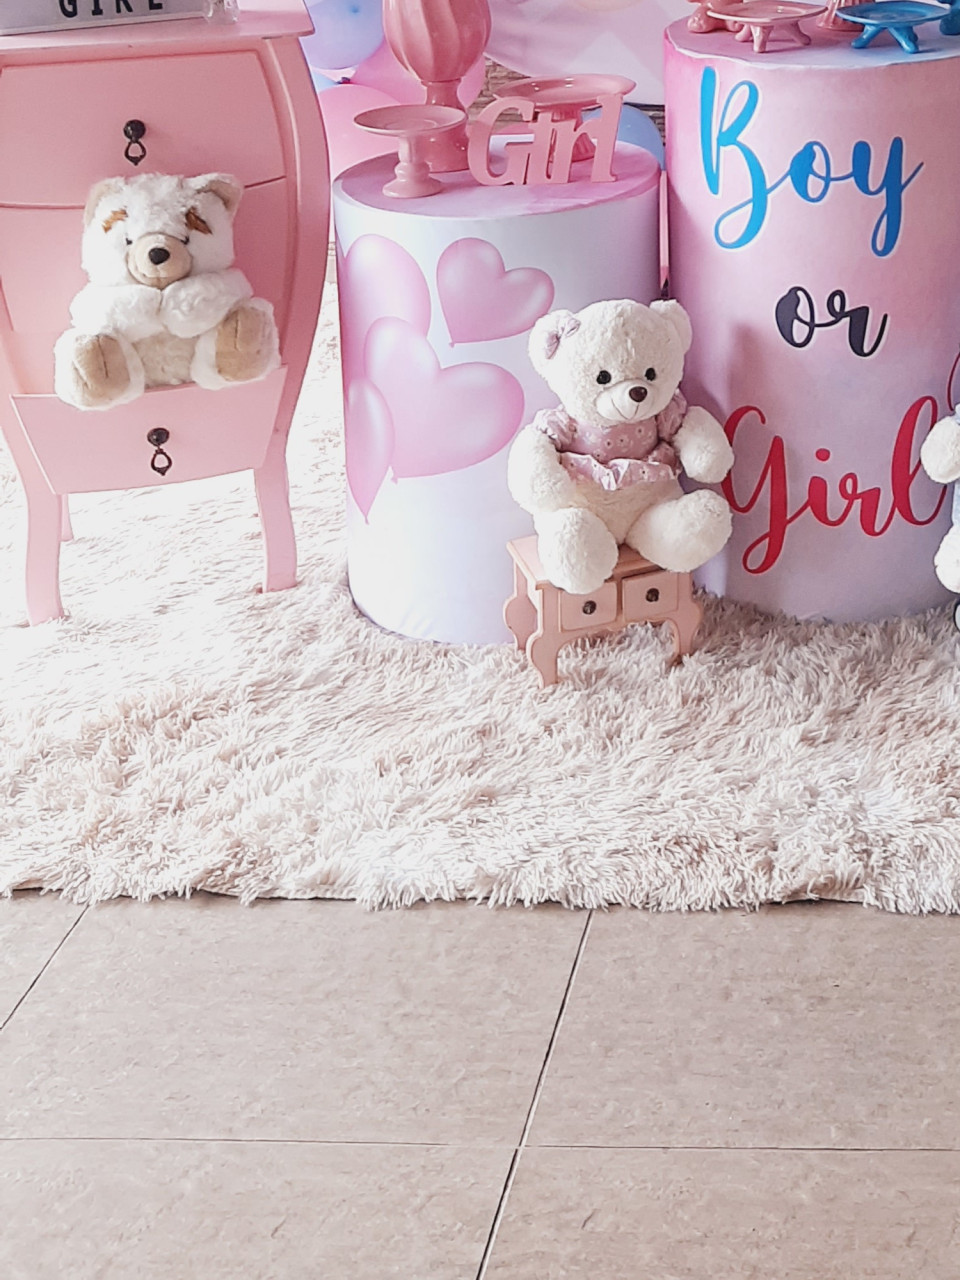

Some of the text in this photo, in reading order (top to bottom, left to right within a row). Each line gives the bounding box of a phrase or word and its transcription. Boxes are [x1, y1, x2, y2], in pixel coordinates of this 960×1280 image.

[467, 92, 624, 186] Girl
[699, 65, 925, 258] Boy
[774, 286, 888, 358] or
[720, 395, 949, 576] Girl
